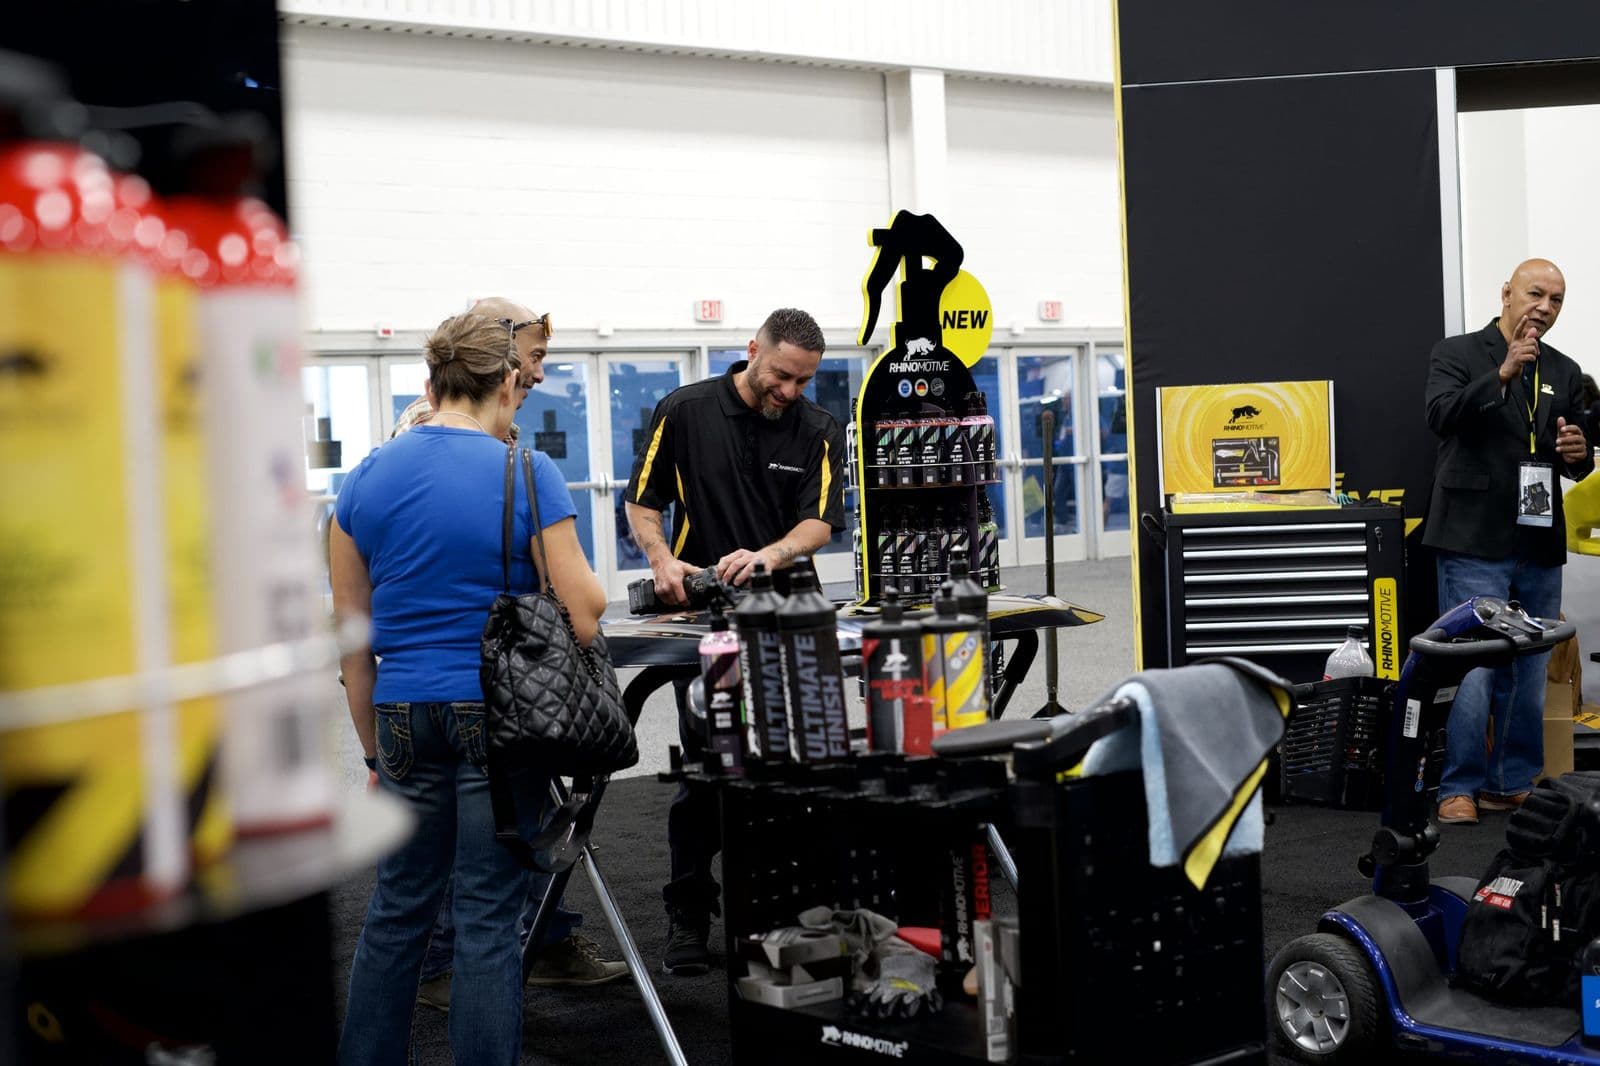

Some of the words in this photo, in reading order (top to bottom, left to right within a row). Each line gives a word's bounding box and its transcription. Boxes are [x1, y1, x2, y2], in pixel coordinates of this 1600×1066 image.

[943, 310, 988, 330] NEW
[889, 360, 950, 373] RHINOMOTIVE
[1380, 587, 1393, 671] RHINOMOTIVE
[758, 632, 789, 752] ULTIMATE
[793, 634, 827, 759] ULTIMATE
[821, 675, 848, 757] FINISH
